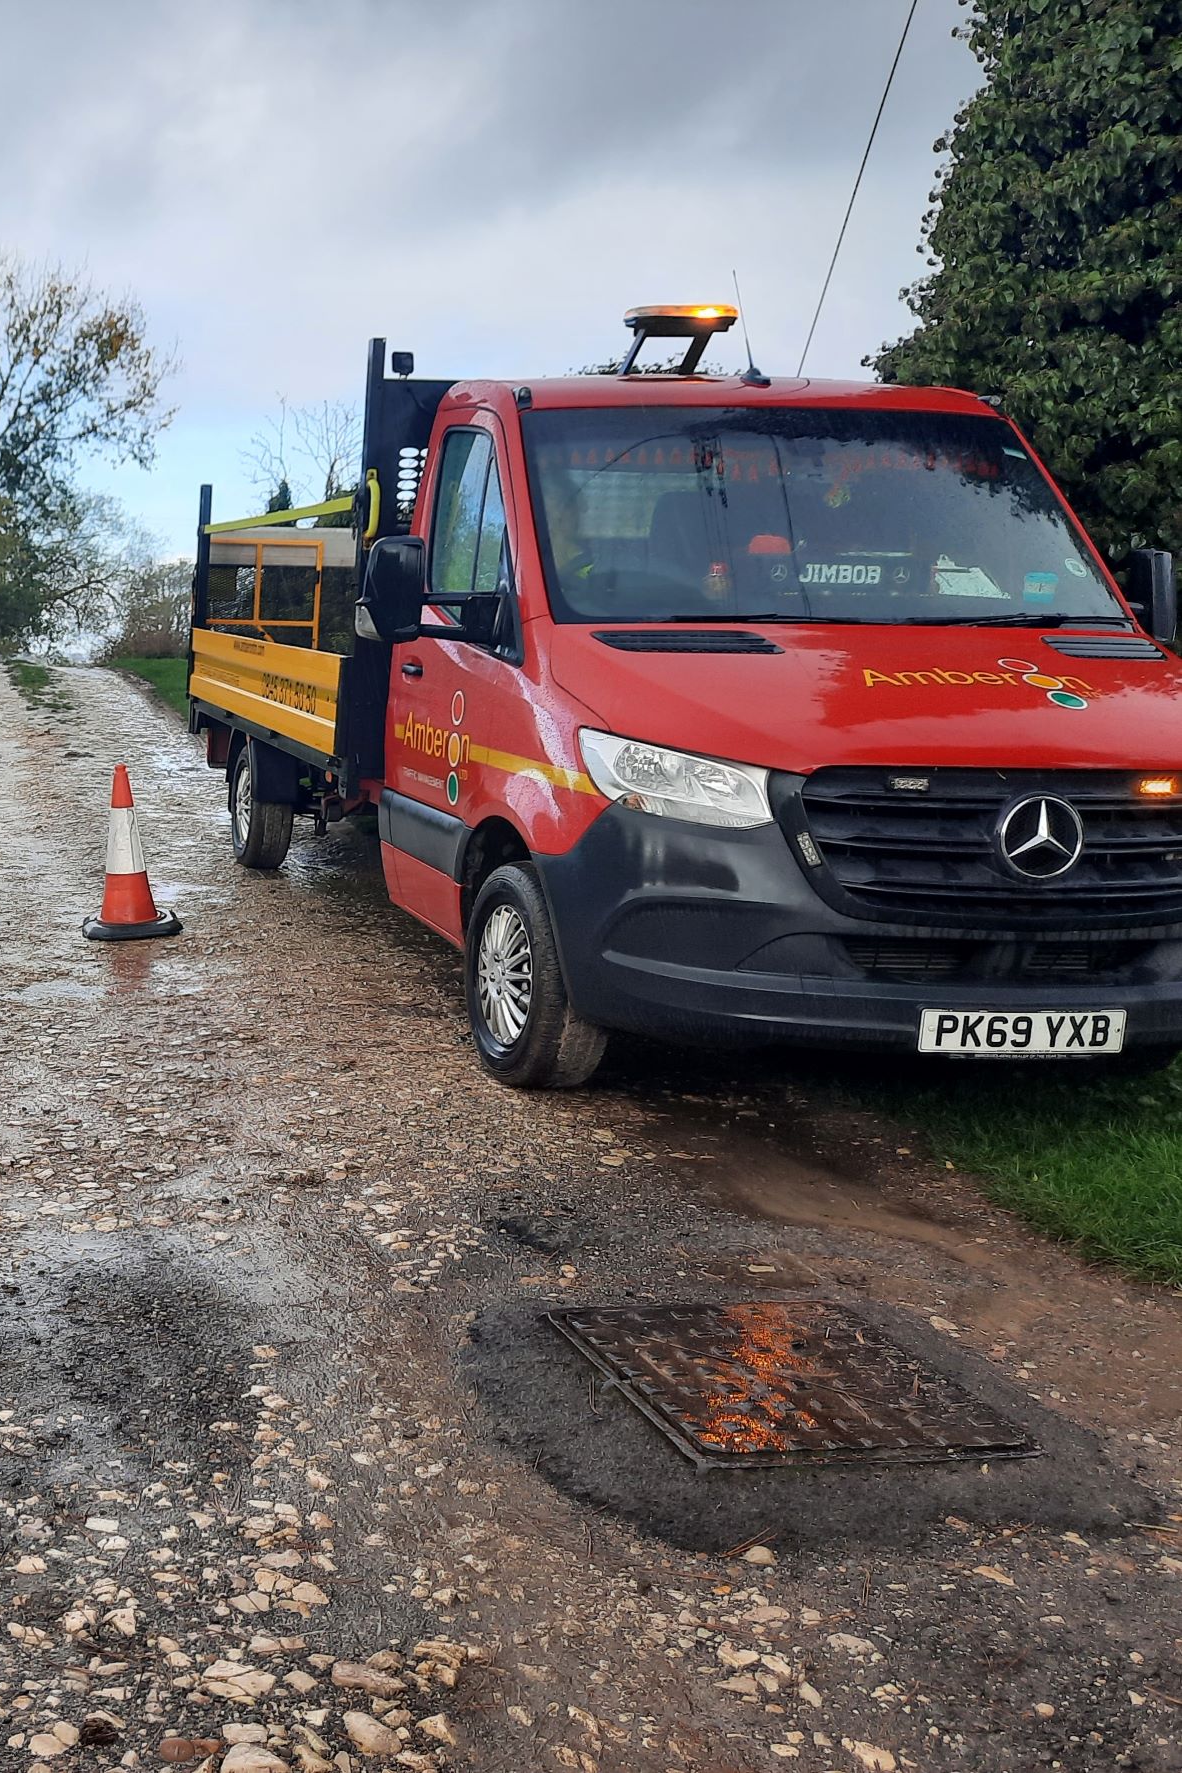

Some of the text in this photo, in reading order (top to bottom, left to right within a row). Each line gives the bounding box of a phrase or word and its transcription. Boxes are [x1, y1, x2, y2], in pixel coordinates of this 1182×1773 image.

[799, 563, 882, 584] JIMBOB
[935, 1015, 1111, 1048] PK69 YXB
